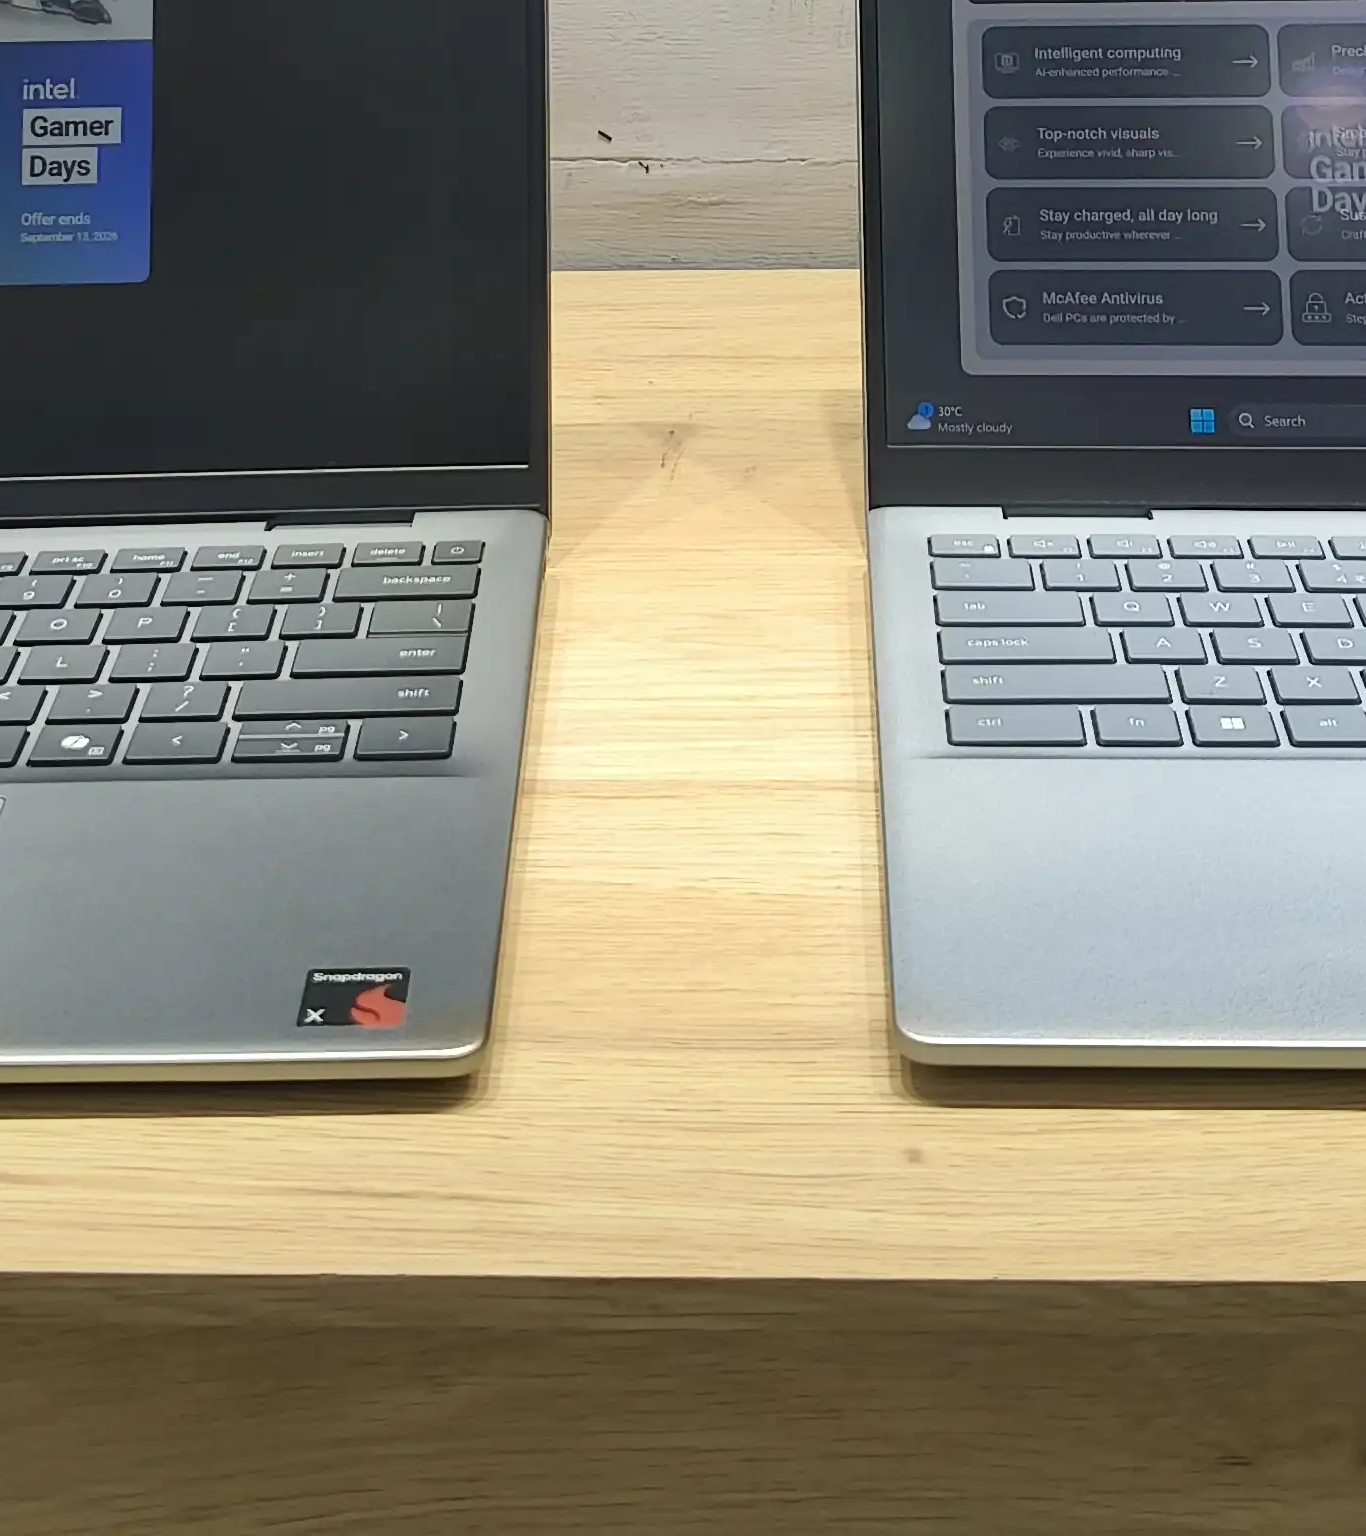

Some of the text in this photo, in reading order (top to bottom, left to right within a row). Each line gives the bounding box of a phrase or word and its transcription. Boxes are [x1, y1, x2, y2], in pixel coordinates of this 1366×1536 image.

[1035, 46, 1182, 62] Intelligent computing
[22, 78, 76, 100] intel
[30, 115, 114, 138] Gamer
[1037, 127, 1160, 144] Top-notch visuals
[29, 154, 91, 183] Days
[21, 212, 91, 226] Offer ends
[1040, 208, 1218, 225] Stay charged, all day long
[1040, 230, 1170, 243] Stay productive wherever
[1043, 292, 1164, 306] McAfee Antivirus
[1044, 313, 1063, 324] Dell
[1090, 314, 1107, 324] are
[1109, 313, 1160, 325] protected
[1163, 313, 1176, 326] by
[938, 406, 963, 417] 30°C
[1265, 415, 1306, 428] Search
[938, 421, 1013, 436] Mostly cloudy
[291, 547, 406, 557] insert delete
[383, 574, 451, 585] backspace
[964, 601, 985, 611] tab
[967, 637, 1029, 648] caps lock
[399, 648, 437, 657] enter
[972, 675, 1004, 685] shift
[397, 687, 430, 697] shift
[978, 717, 1002, 728] ctrl
[1319, 718, 1338, 728] alt
[313, 972, 403, 983] Snapdragon
[304, 1008, 326, 1024] X
